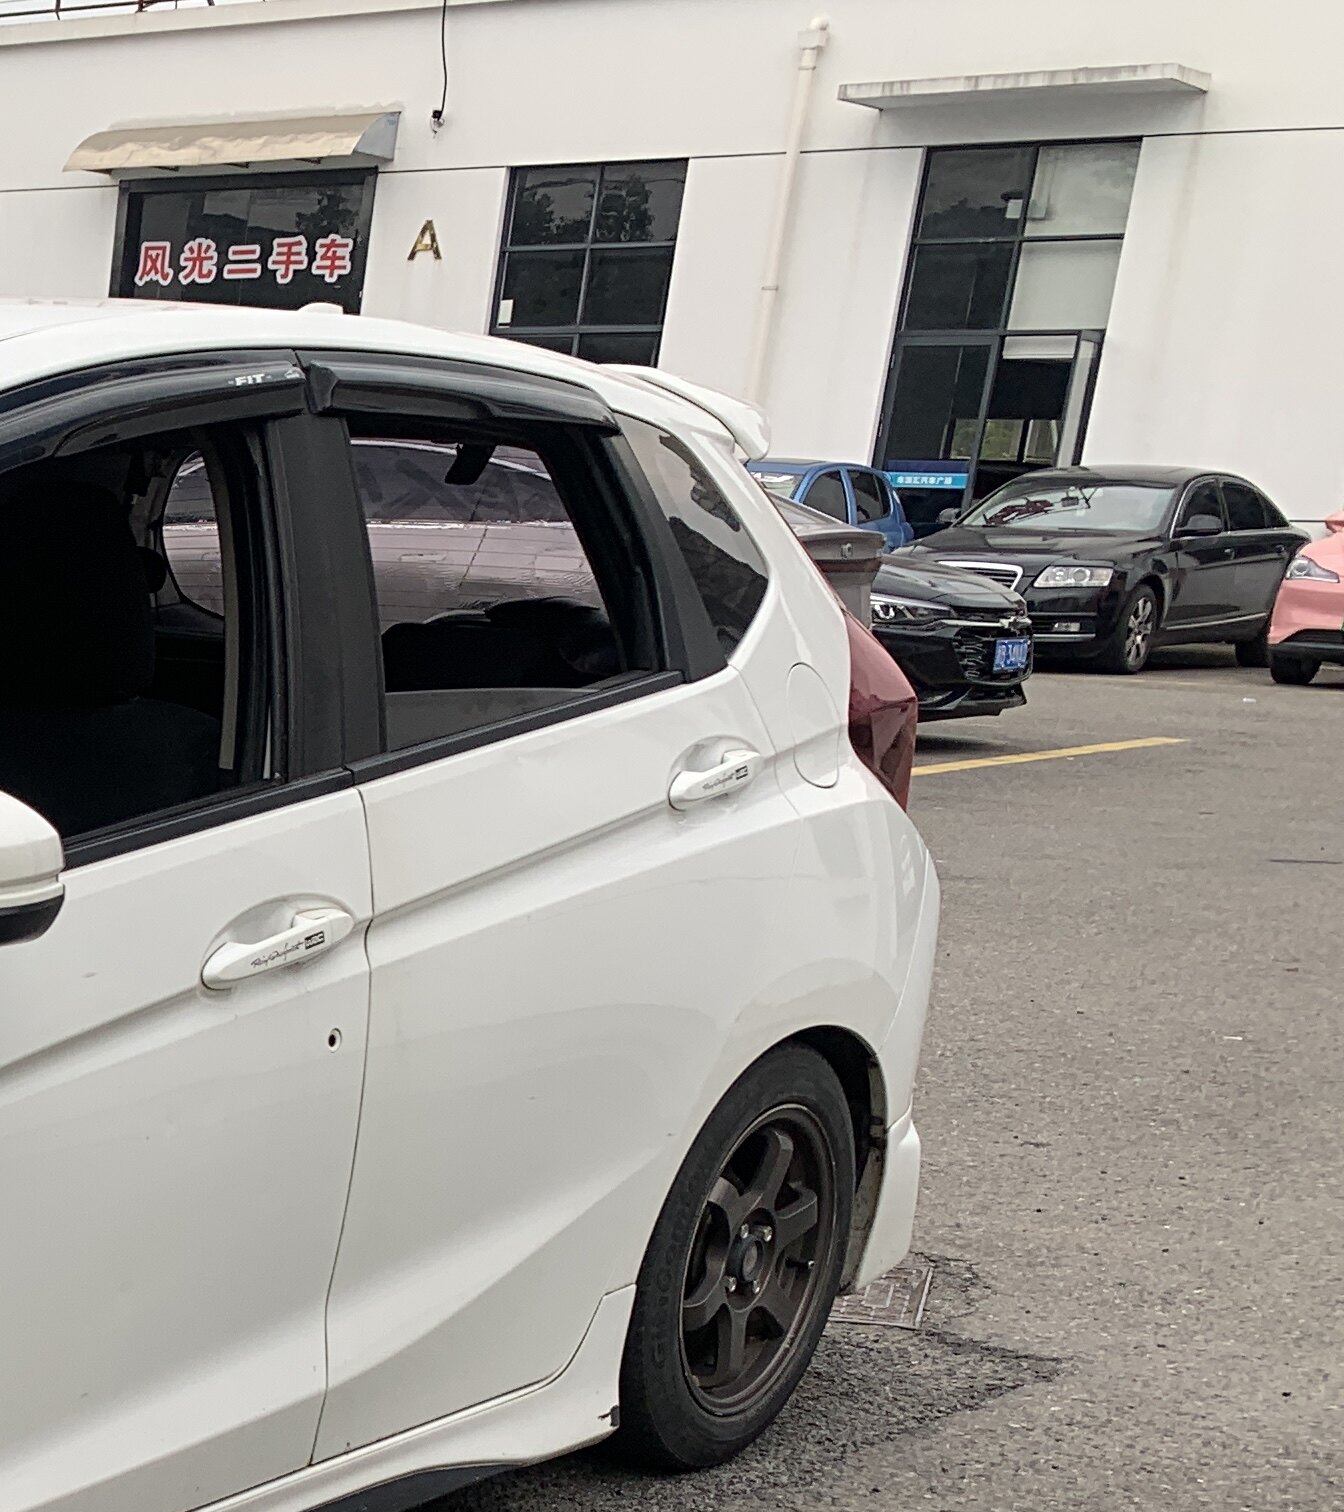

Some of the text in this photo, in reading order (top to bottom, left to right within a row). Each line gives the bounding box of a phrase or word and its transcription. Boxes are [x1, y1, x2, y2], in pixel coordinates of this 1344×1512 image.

[135, 233, 354, 286] 风光二手车
[407, 219, 442, 261] A
